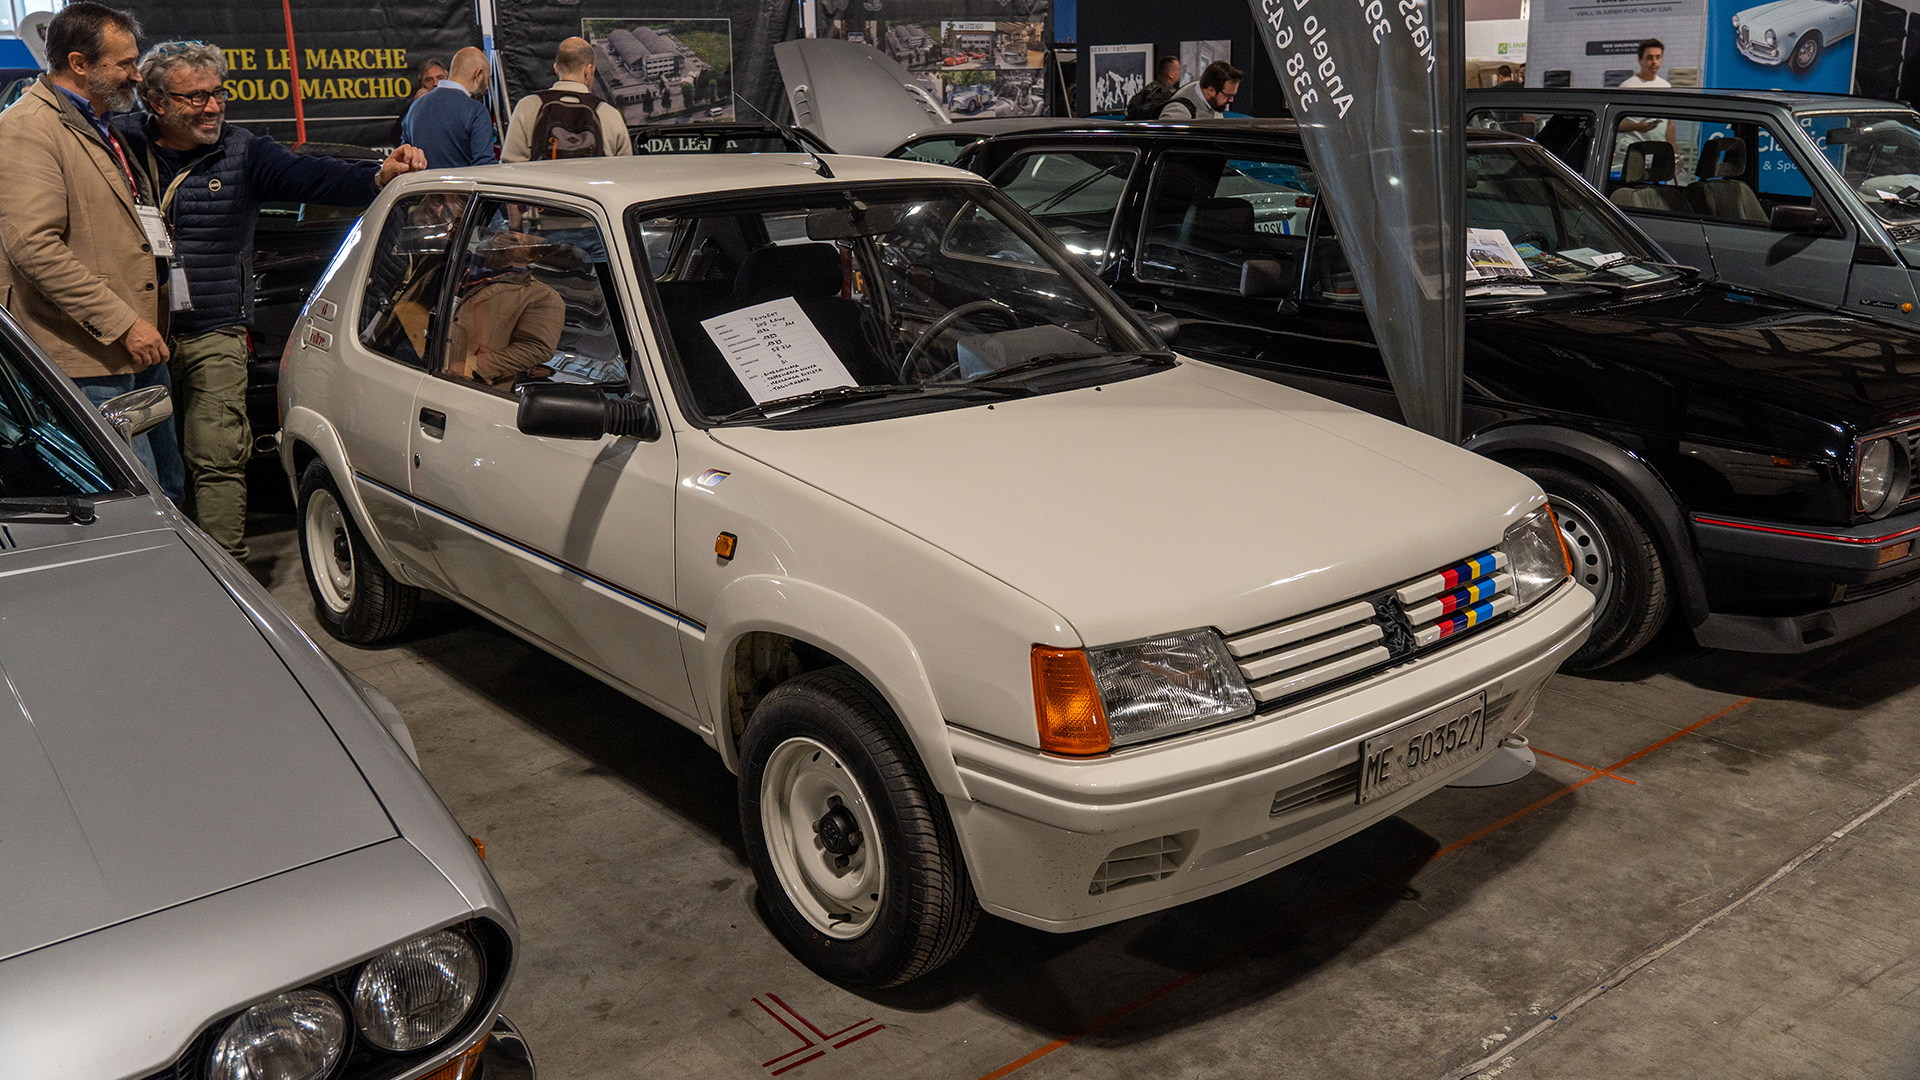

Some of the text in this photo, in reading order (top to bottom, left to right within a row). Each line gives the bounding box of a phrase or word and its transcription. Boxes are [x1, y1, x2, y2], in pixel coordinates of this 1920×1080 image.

[305, 48, 408, 70] MARCHE
[223, 77, 412, 100] SOLO MARCHIO
[1762, 160, 1772, 171] &
[749, 311, 778, 322] PEUGEOT
[1366, 708, 1483, 789] ME 503527
